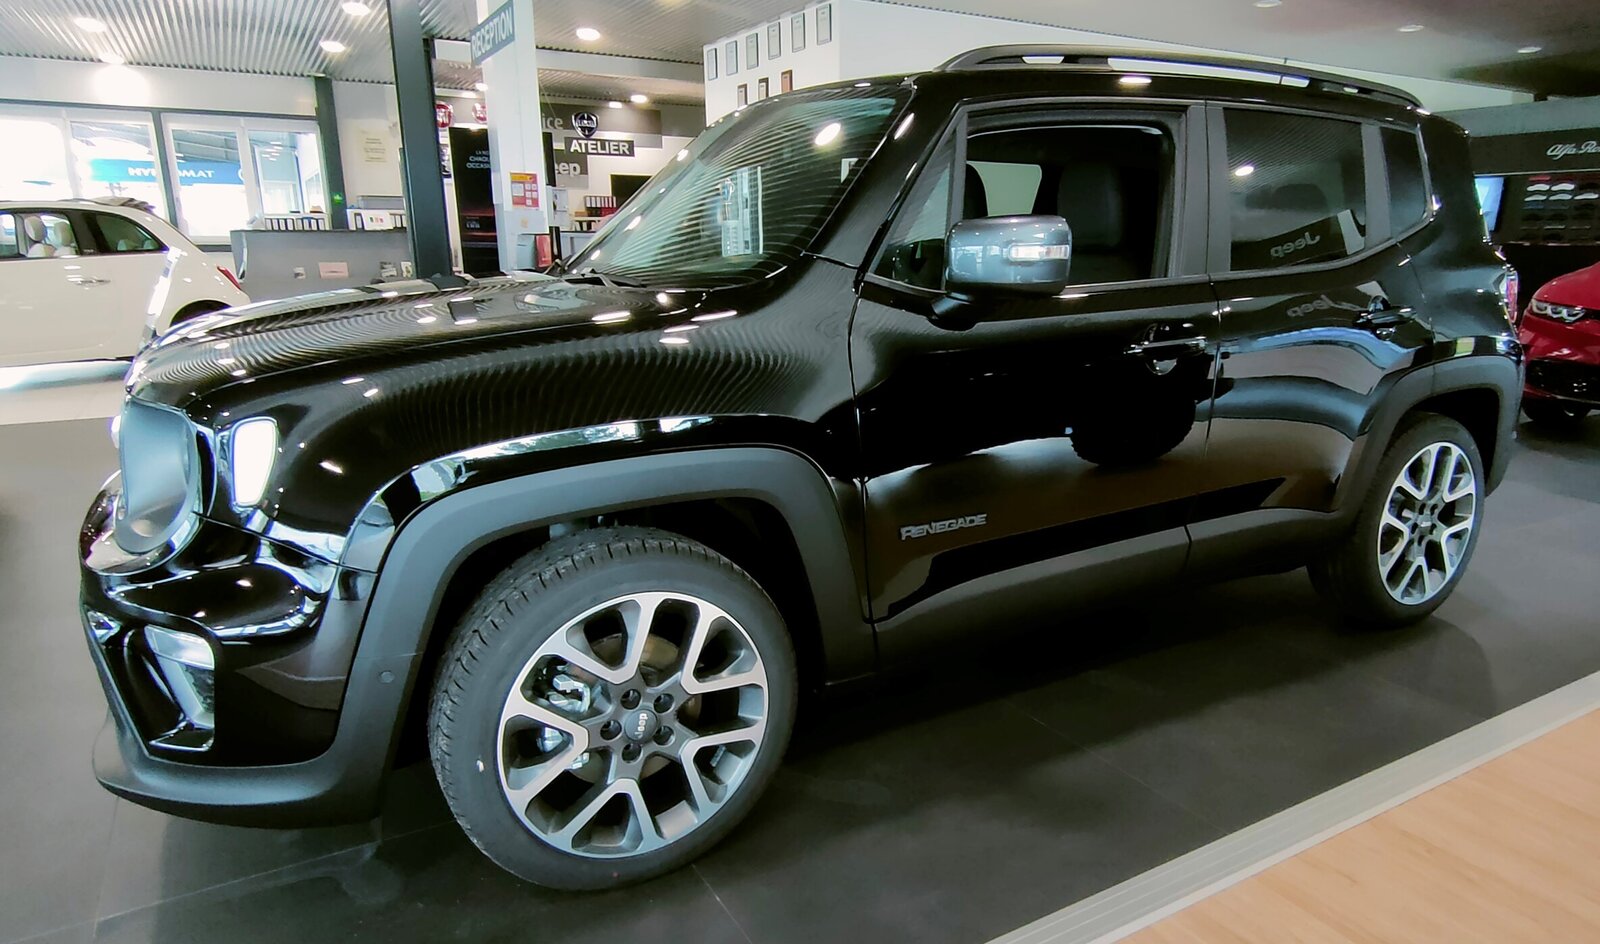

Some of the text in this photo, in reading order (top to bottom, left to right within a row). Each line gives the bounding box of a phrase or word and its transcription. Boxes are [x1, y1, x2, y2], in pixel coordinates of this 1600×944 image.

[471, 7, 513, 60] RECEPTION
[570, 140, 630, 155] ATELIER
[1547, 143, 1577, 160] Alfa
[900, 514, 987, 540] RENEGADE
[634, 713, 648, 739] Jeep
